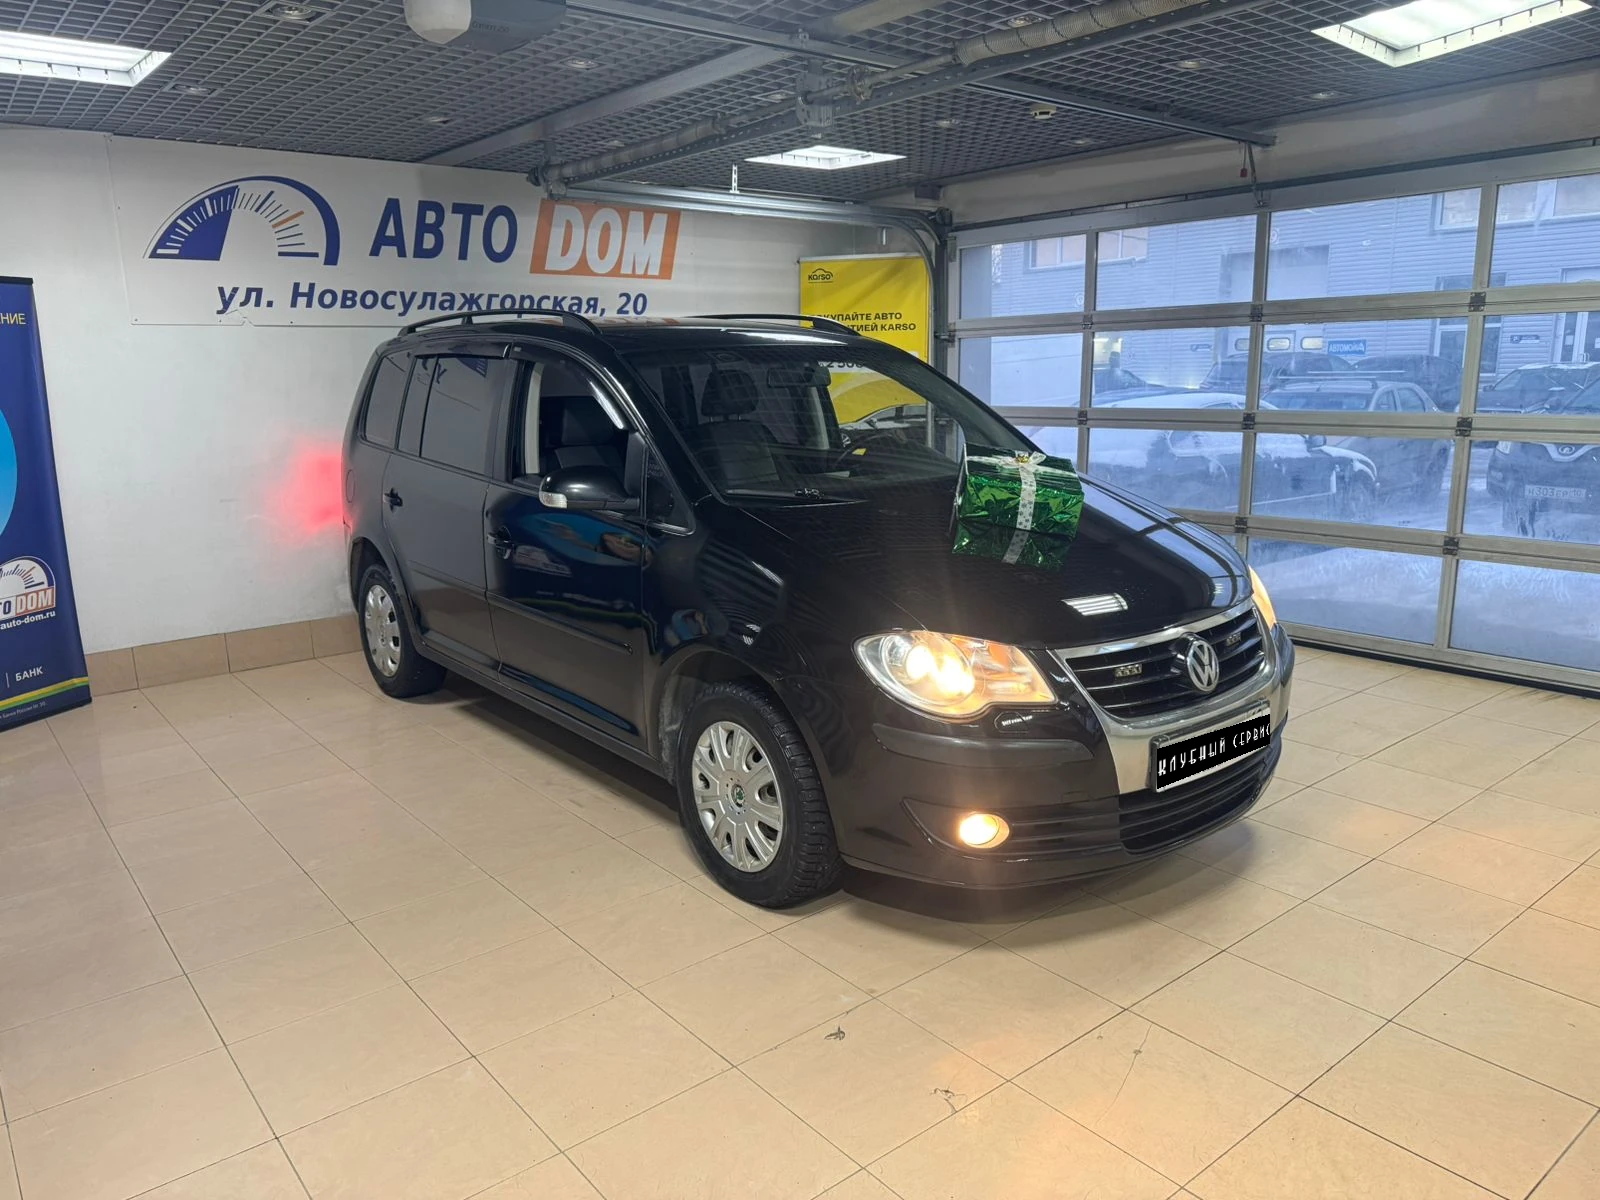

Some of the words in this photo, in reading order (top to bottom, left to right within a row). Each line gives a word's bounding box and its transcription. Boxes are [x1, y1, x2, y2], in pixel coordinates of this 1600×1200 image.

[369, 197, 518, 264] АВТО
[544, 203, 669, 276] DOM
[216, 286, 274, 315] ул.
[290, 282, 606, 319] Новосулажгорская,
[616, 292, 648, 316] 20
[815, 311, 872, 322] УПАЙТЕ
[873, 312, 903, 321] АВТО
[880, 322, 917, 332] KARSO
[16, 589, 53, 614] DOM
[15, 666, 43, 682] БАНК
